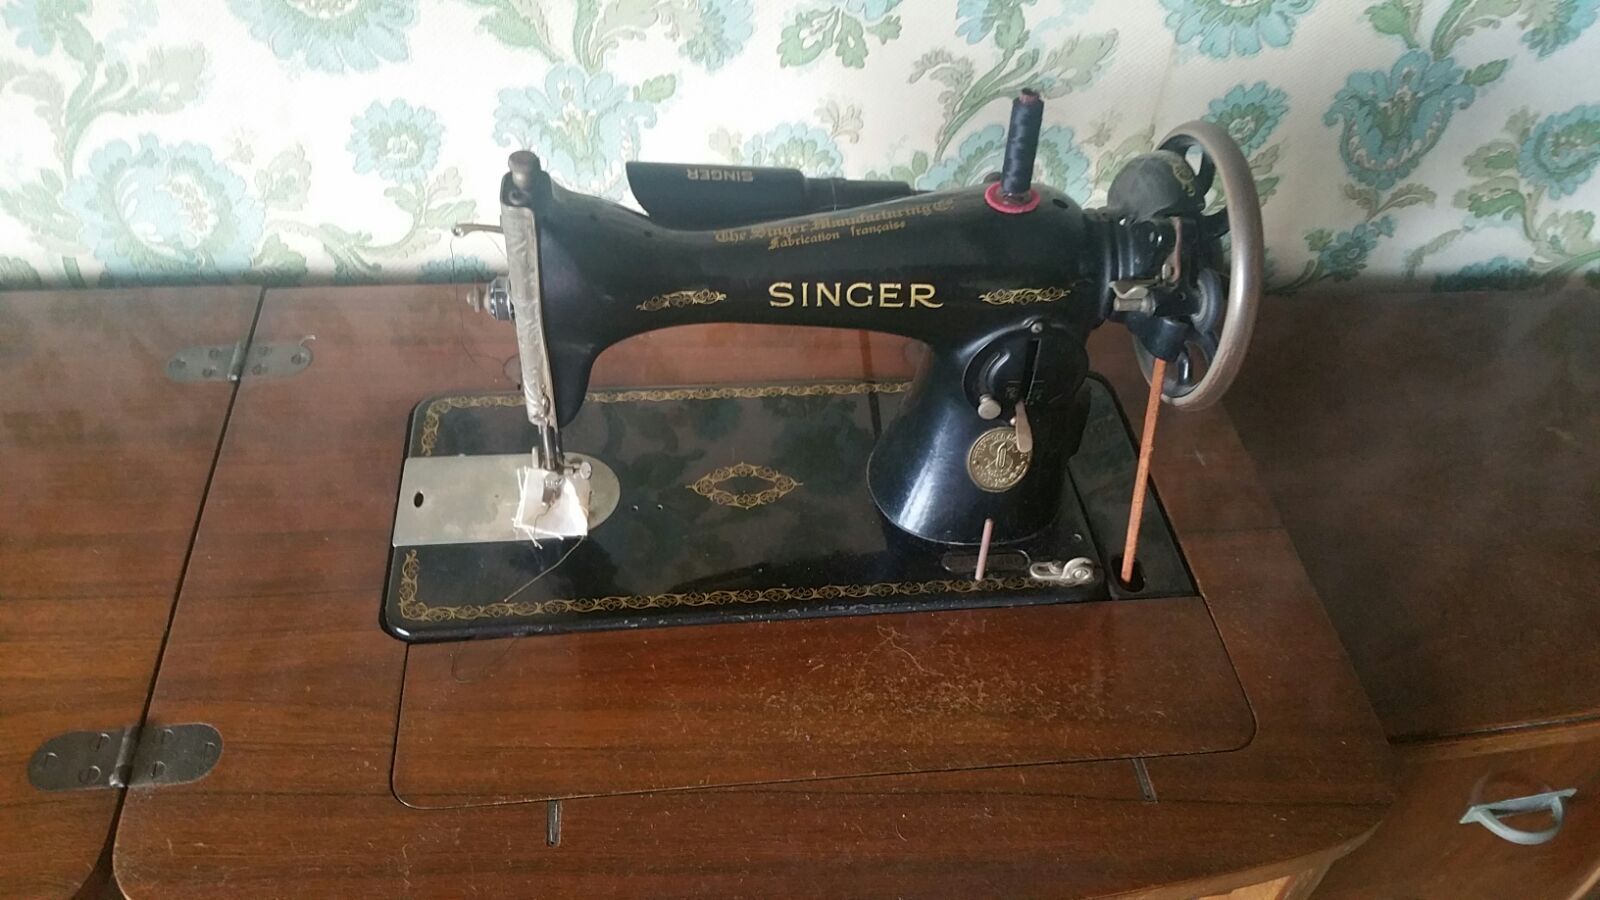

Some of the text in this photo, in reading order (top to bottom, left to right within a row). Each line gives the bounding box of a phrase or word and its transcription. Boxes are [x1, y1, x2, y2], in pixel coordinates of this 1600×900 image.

[686, 168, 754, 182] SINGER
[713, 229, 747, 242] The
[750, 223, 809, 241] Singer
[767, 231, 840, 250] Fabrication
[768, 282, 944, 309] SINGER
